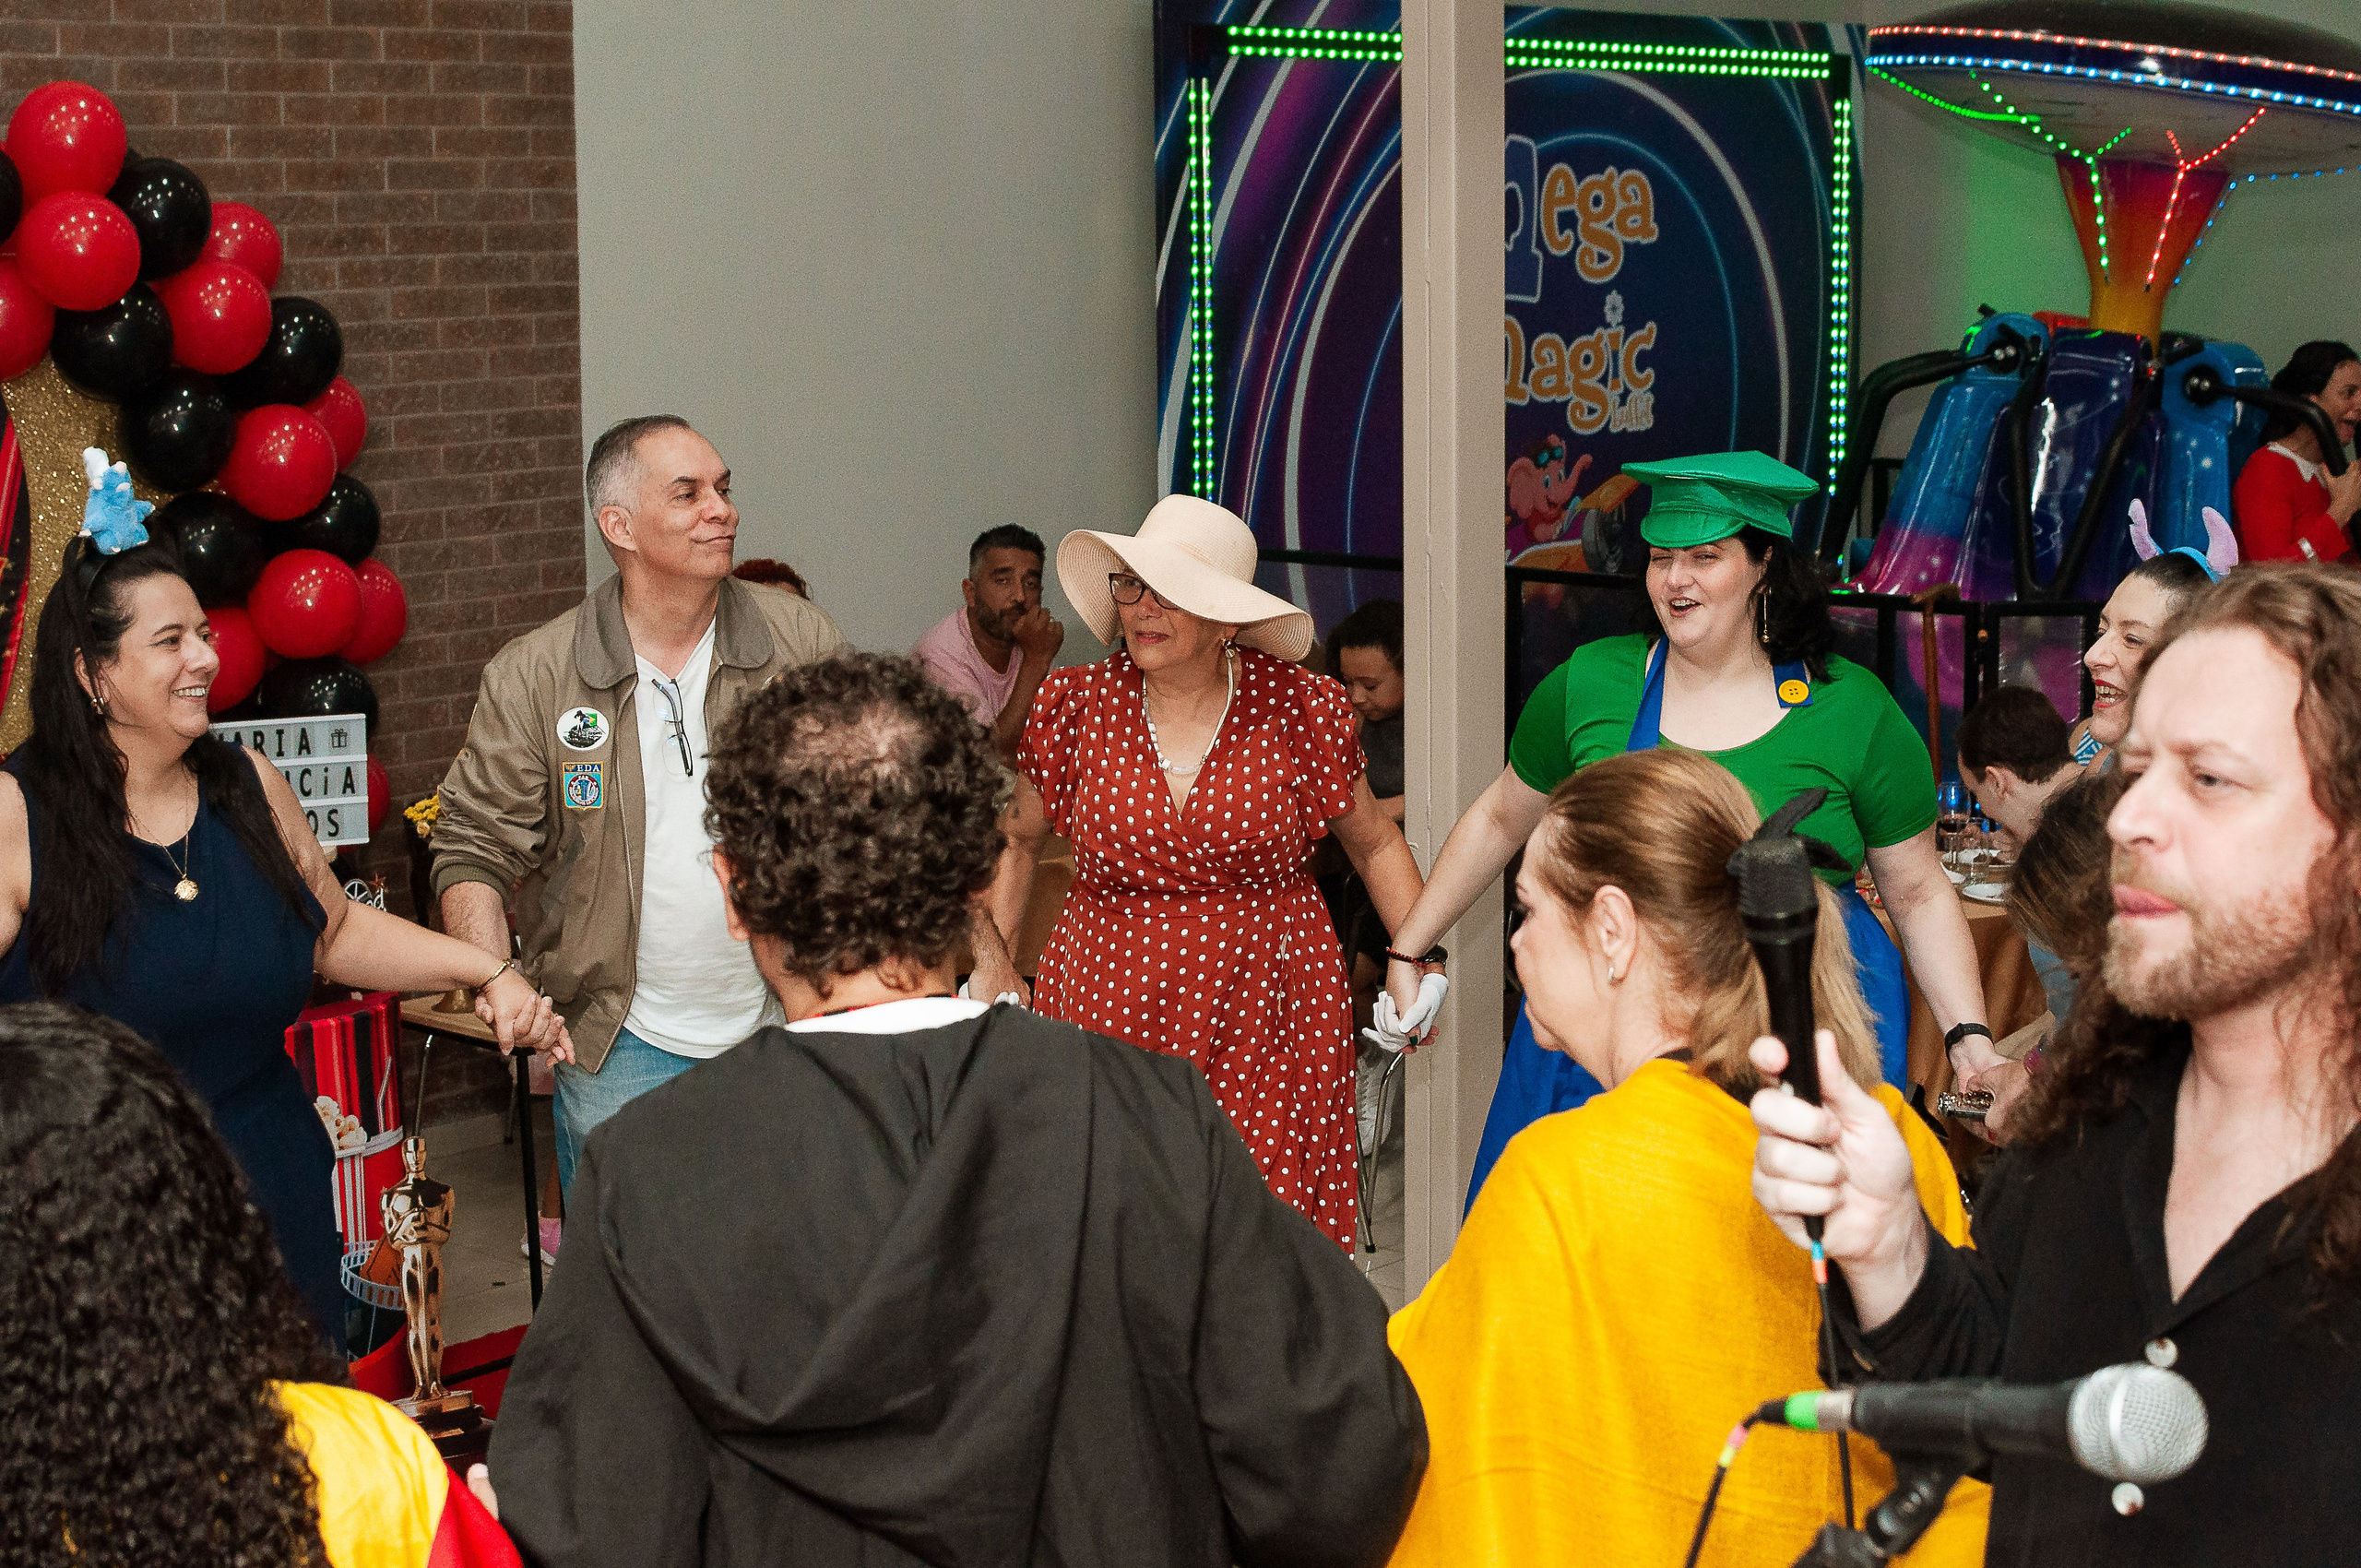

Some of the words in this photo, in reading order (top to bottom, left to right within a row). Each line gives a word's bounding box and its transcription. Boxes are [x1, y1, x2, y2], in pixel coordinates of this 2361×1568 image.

[219, 727, 311, 757] RIA
[285, 766, 356, 797] CiA
[577, 764, 600, 772] EDA
